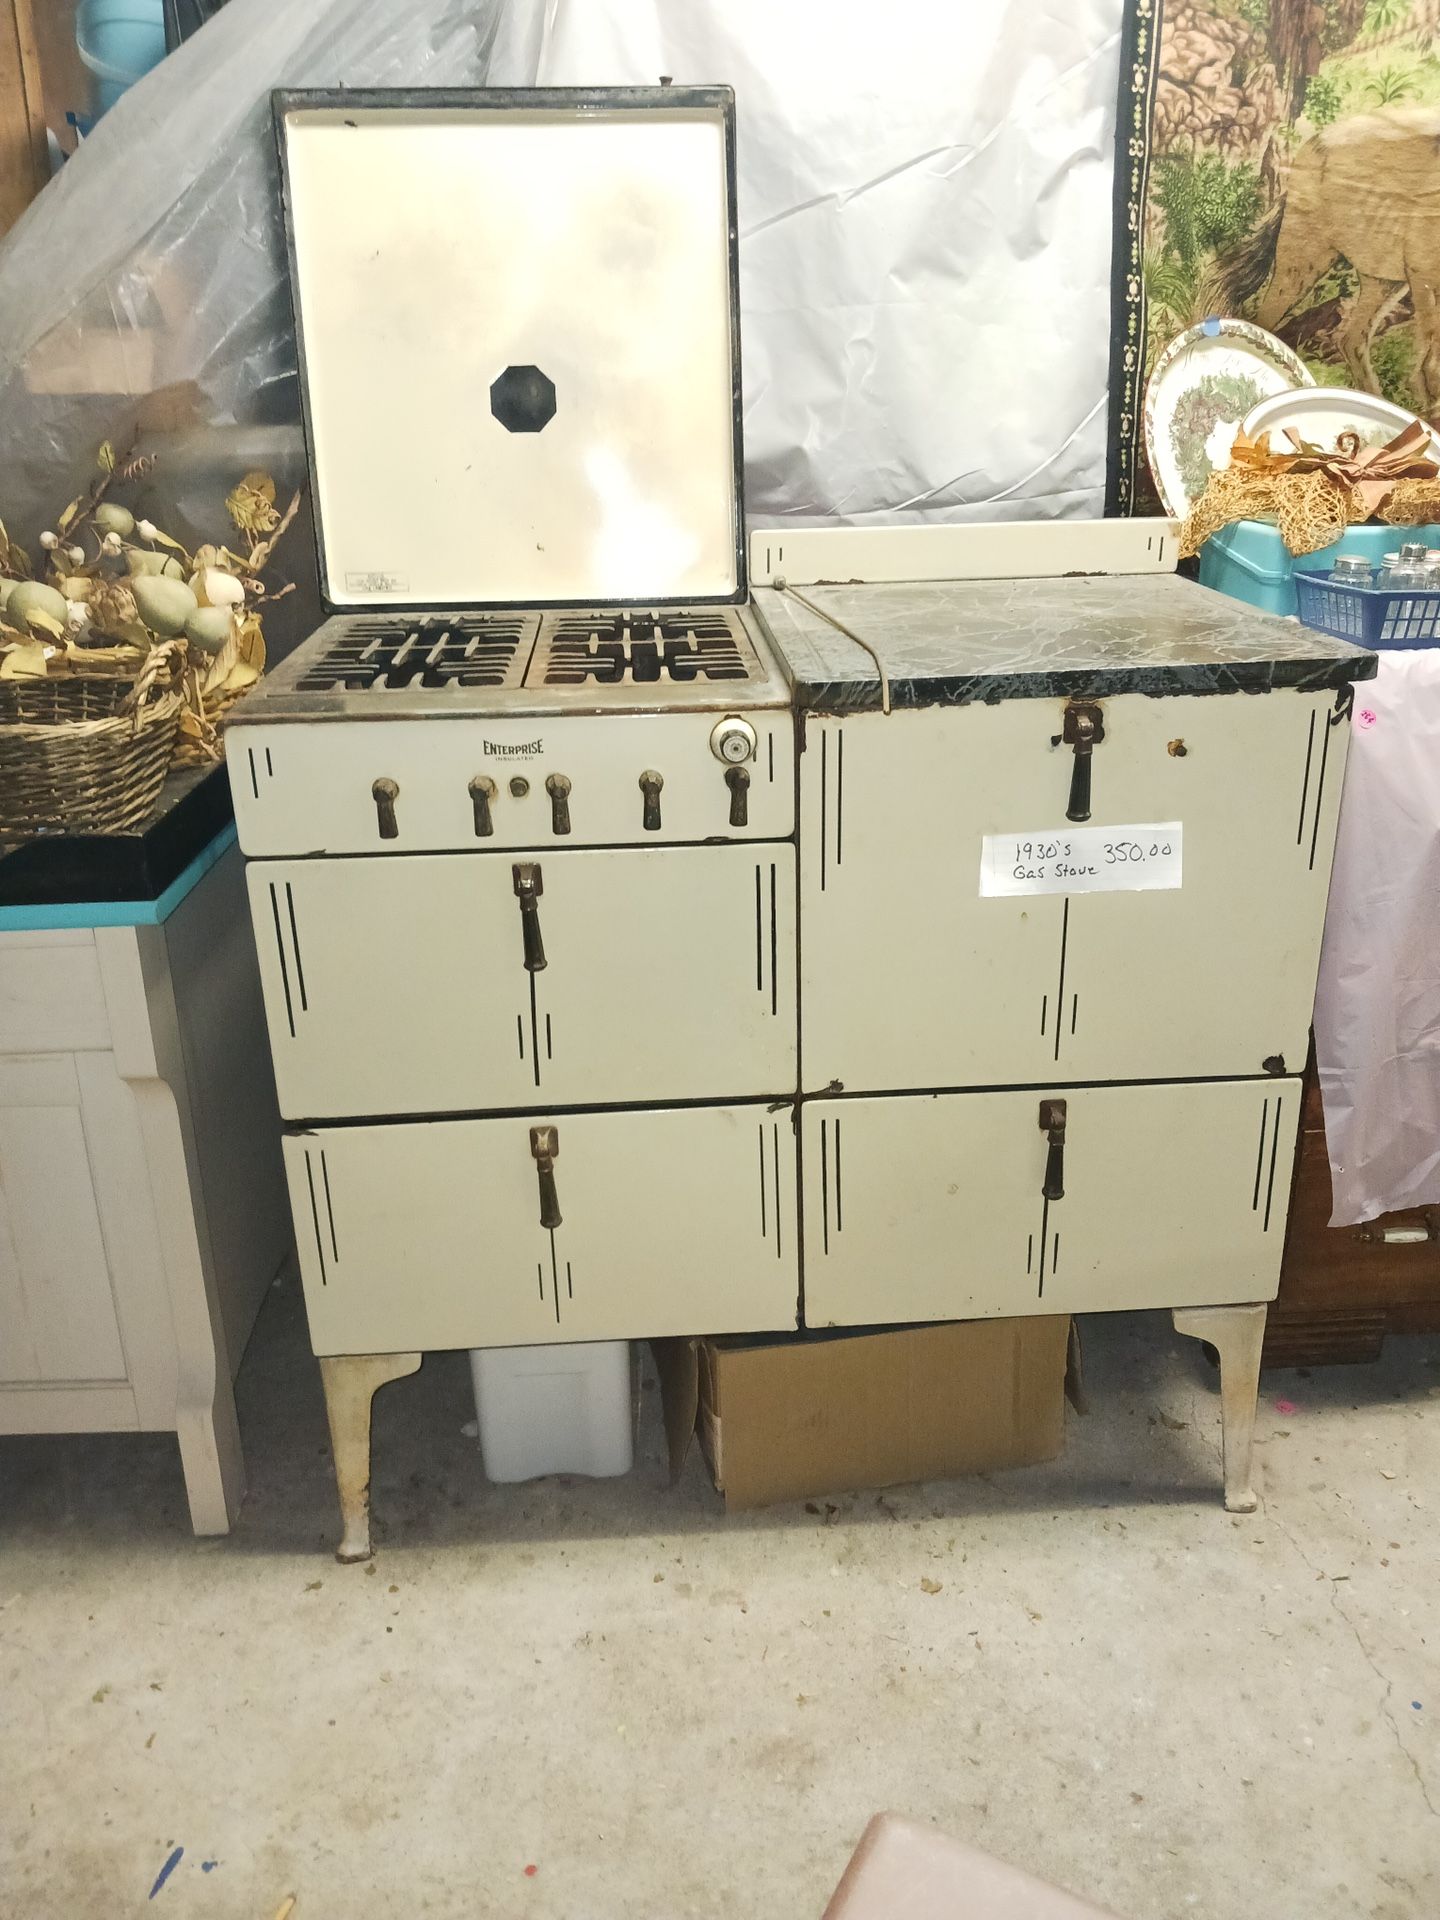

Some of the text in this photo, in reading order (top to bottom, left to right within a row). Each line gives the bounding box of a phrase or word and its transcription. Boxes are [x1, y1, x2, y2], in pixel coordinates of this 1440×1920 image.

[483, 738, 544, 755] ENTERPRISE
[1015, 840, 1172, 864] 1930's 350.00
[1013, 864, 1045, 880] Gas
